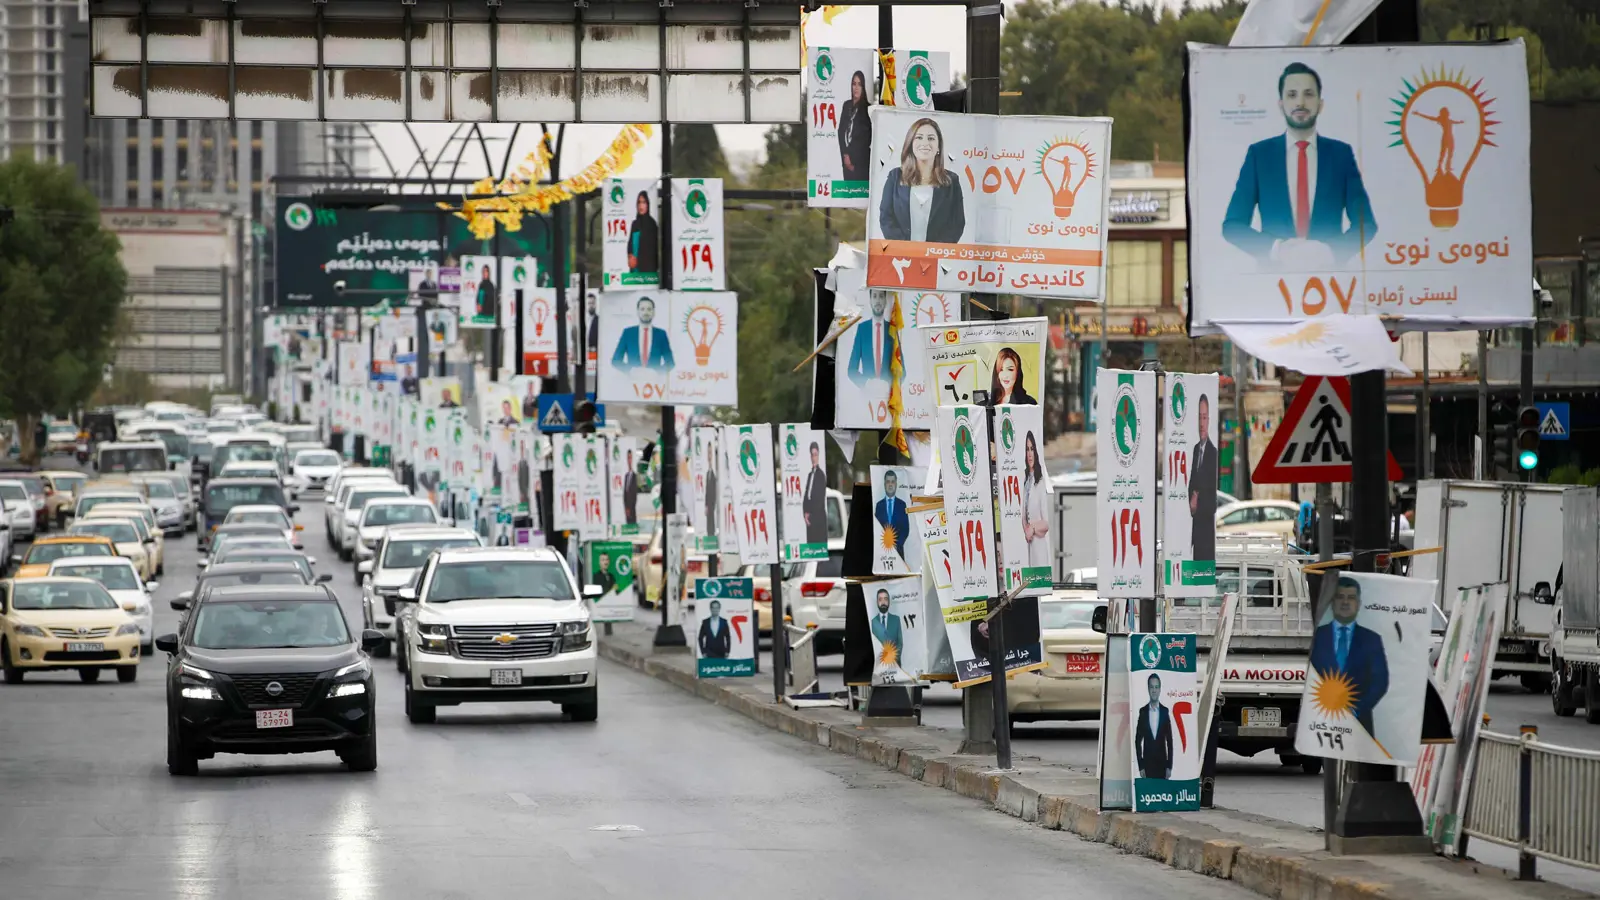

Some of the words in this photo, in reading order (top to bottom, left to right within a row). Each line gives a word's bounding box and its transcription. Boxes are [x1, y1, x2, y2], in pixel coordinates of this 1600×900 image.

[813, 103, 837, 129] ١٢٩
[962, 146, 989, 160] ژمارە
[991, 148, 1025, 161] لیستی
[817, 182, 830, 196] ٥٤
[964, 164, 1026, 195] ١٥٧
[607, 218, 628, 237] ١٢٩
[1027, 221, 1054, 236] نوێ
[1058, 224, 1099, 237] نەوەی
[681, 243, 714, 274] ١٢٩
[1011, 248, 1046, 261] خۆشی
[1384, 235, 1429, 265] نوێ
[1438, 235, 1509, 264] نەوەی
[891, 256, 912, 284] ٣
[957, 264, 1005, 288] ژمارە
[1010, 268, 1085, 290] کاندیدی
[1278, 275, 1357, 315] ١٥٧
[1368, 285, 1404, 306] ژمارە
[1409, 285, 1457, 305] لیستی
[932, 351, 949, 361] ژمارە
[633, 383, 666, 399] ١٥٧
[944, 384, 969, 403] ٦٠
[868, 400, 887, 423] ١٥
[1169, 450, 1188, 487] ١٢٩
[785, 475, 802, 498] ١٢٩
[1003, 475, 1021, 507] ١٢٩
[561, 490, 577, 514] ١٢٩
[585, 498, 602, 524] ١٢٩
[744, 508, 769, 546] ١٢٩
[958, 519, 987, 571] ١٢٩
[1111, 508, 1143, 569] ١٢٩
[731, 615, 748, 645] ٢
[903, 613, 917, 630] ١٣
[1394, 621, 1402, 643] ١
[1165, 636, 1187, 649] لیستی
[1169, 654, 1187, 668] ١٢٩
[1245, 669, 1306, 681] MOTOR
[263, 711, 289, 719] 21-24
[263, 718, 289, 726] 67970
[1172, 701, 1192, 754] ٢
[1316, 732, 1344, 751] ١٦٩
[1140, 790, 1173, 808] مەحمود
